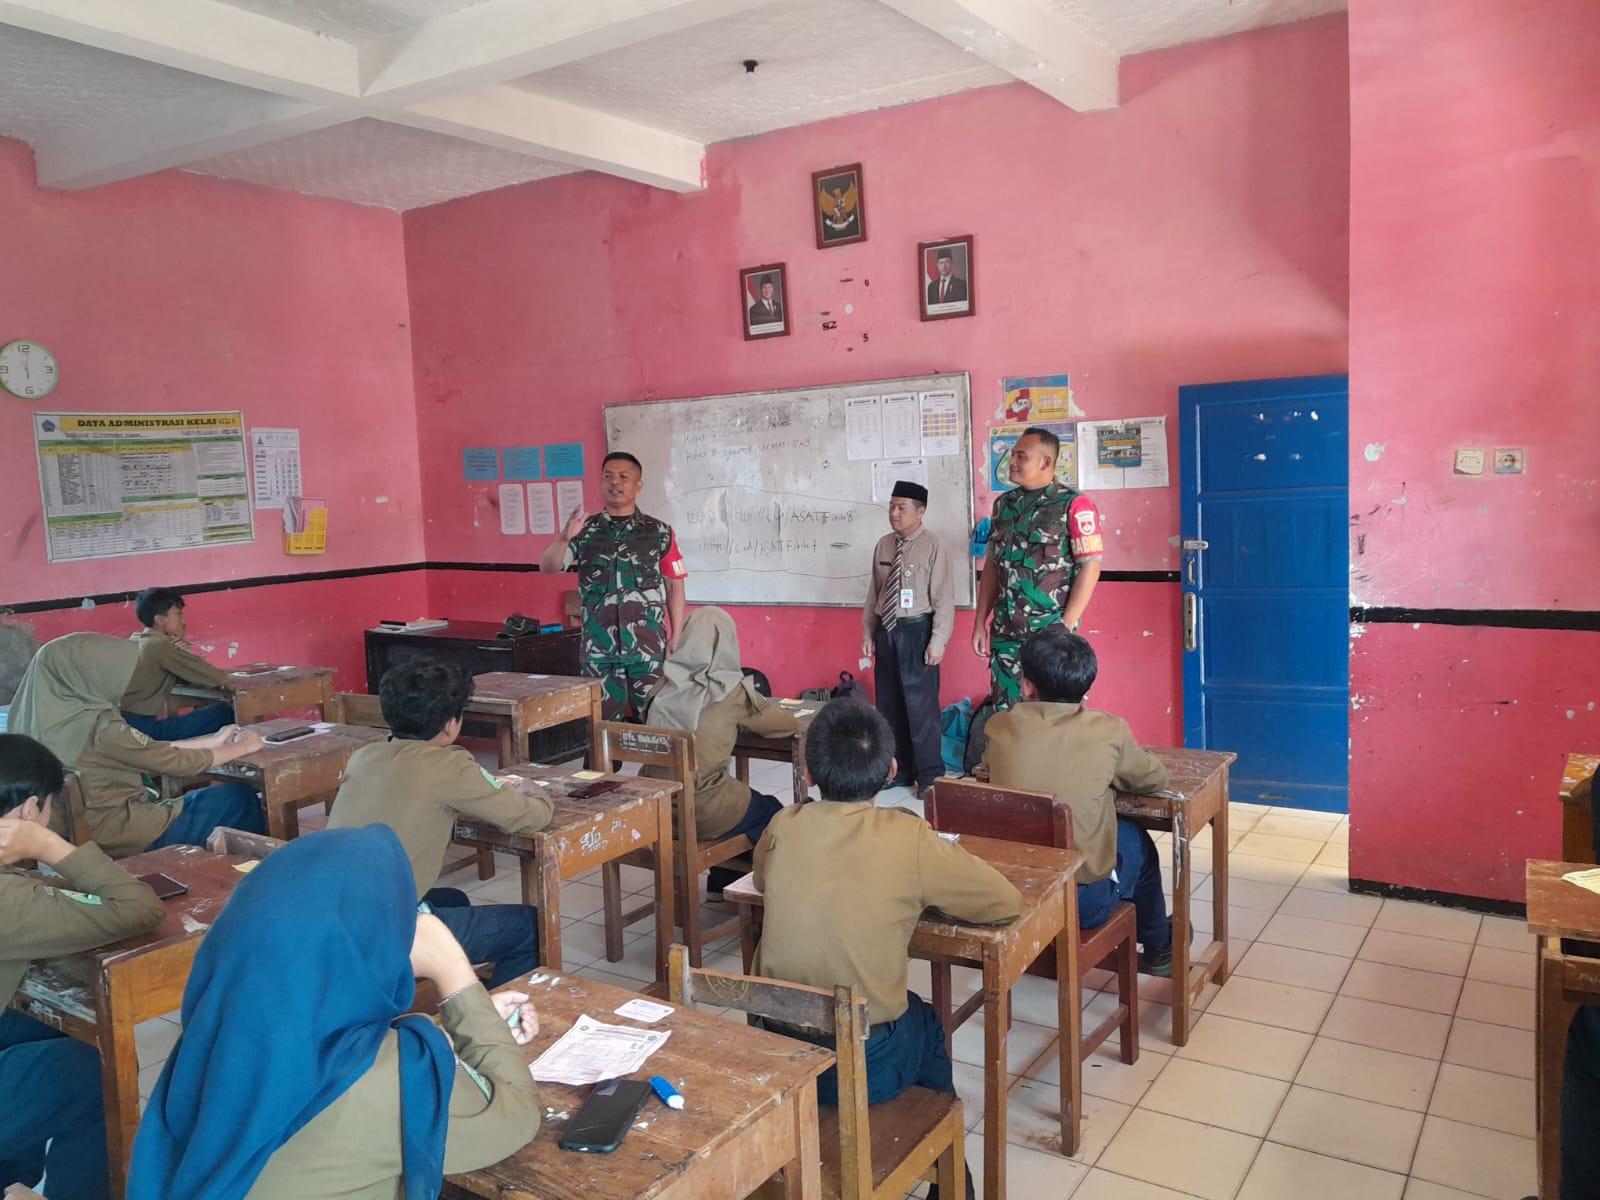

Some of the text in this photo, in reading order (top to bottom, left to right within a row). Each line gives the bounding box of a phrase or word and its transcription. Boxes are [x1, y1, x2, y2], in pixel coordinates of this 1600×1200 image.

[17, 344, 31, 353] 12
[44, 366, 53, 374] 3
[25, 386, 34, 394] 6
[78, 419, 107, 427] DATA
[108, 418, 184, 428] ADMINISTRASI
[186, 417, 217, 426] KELAS
